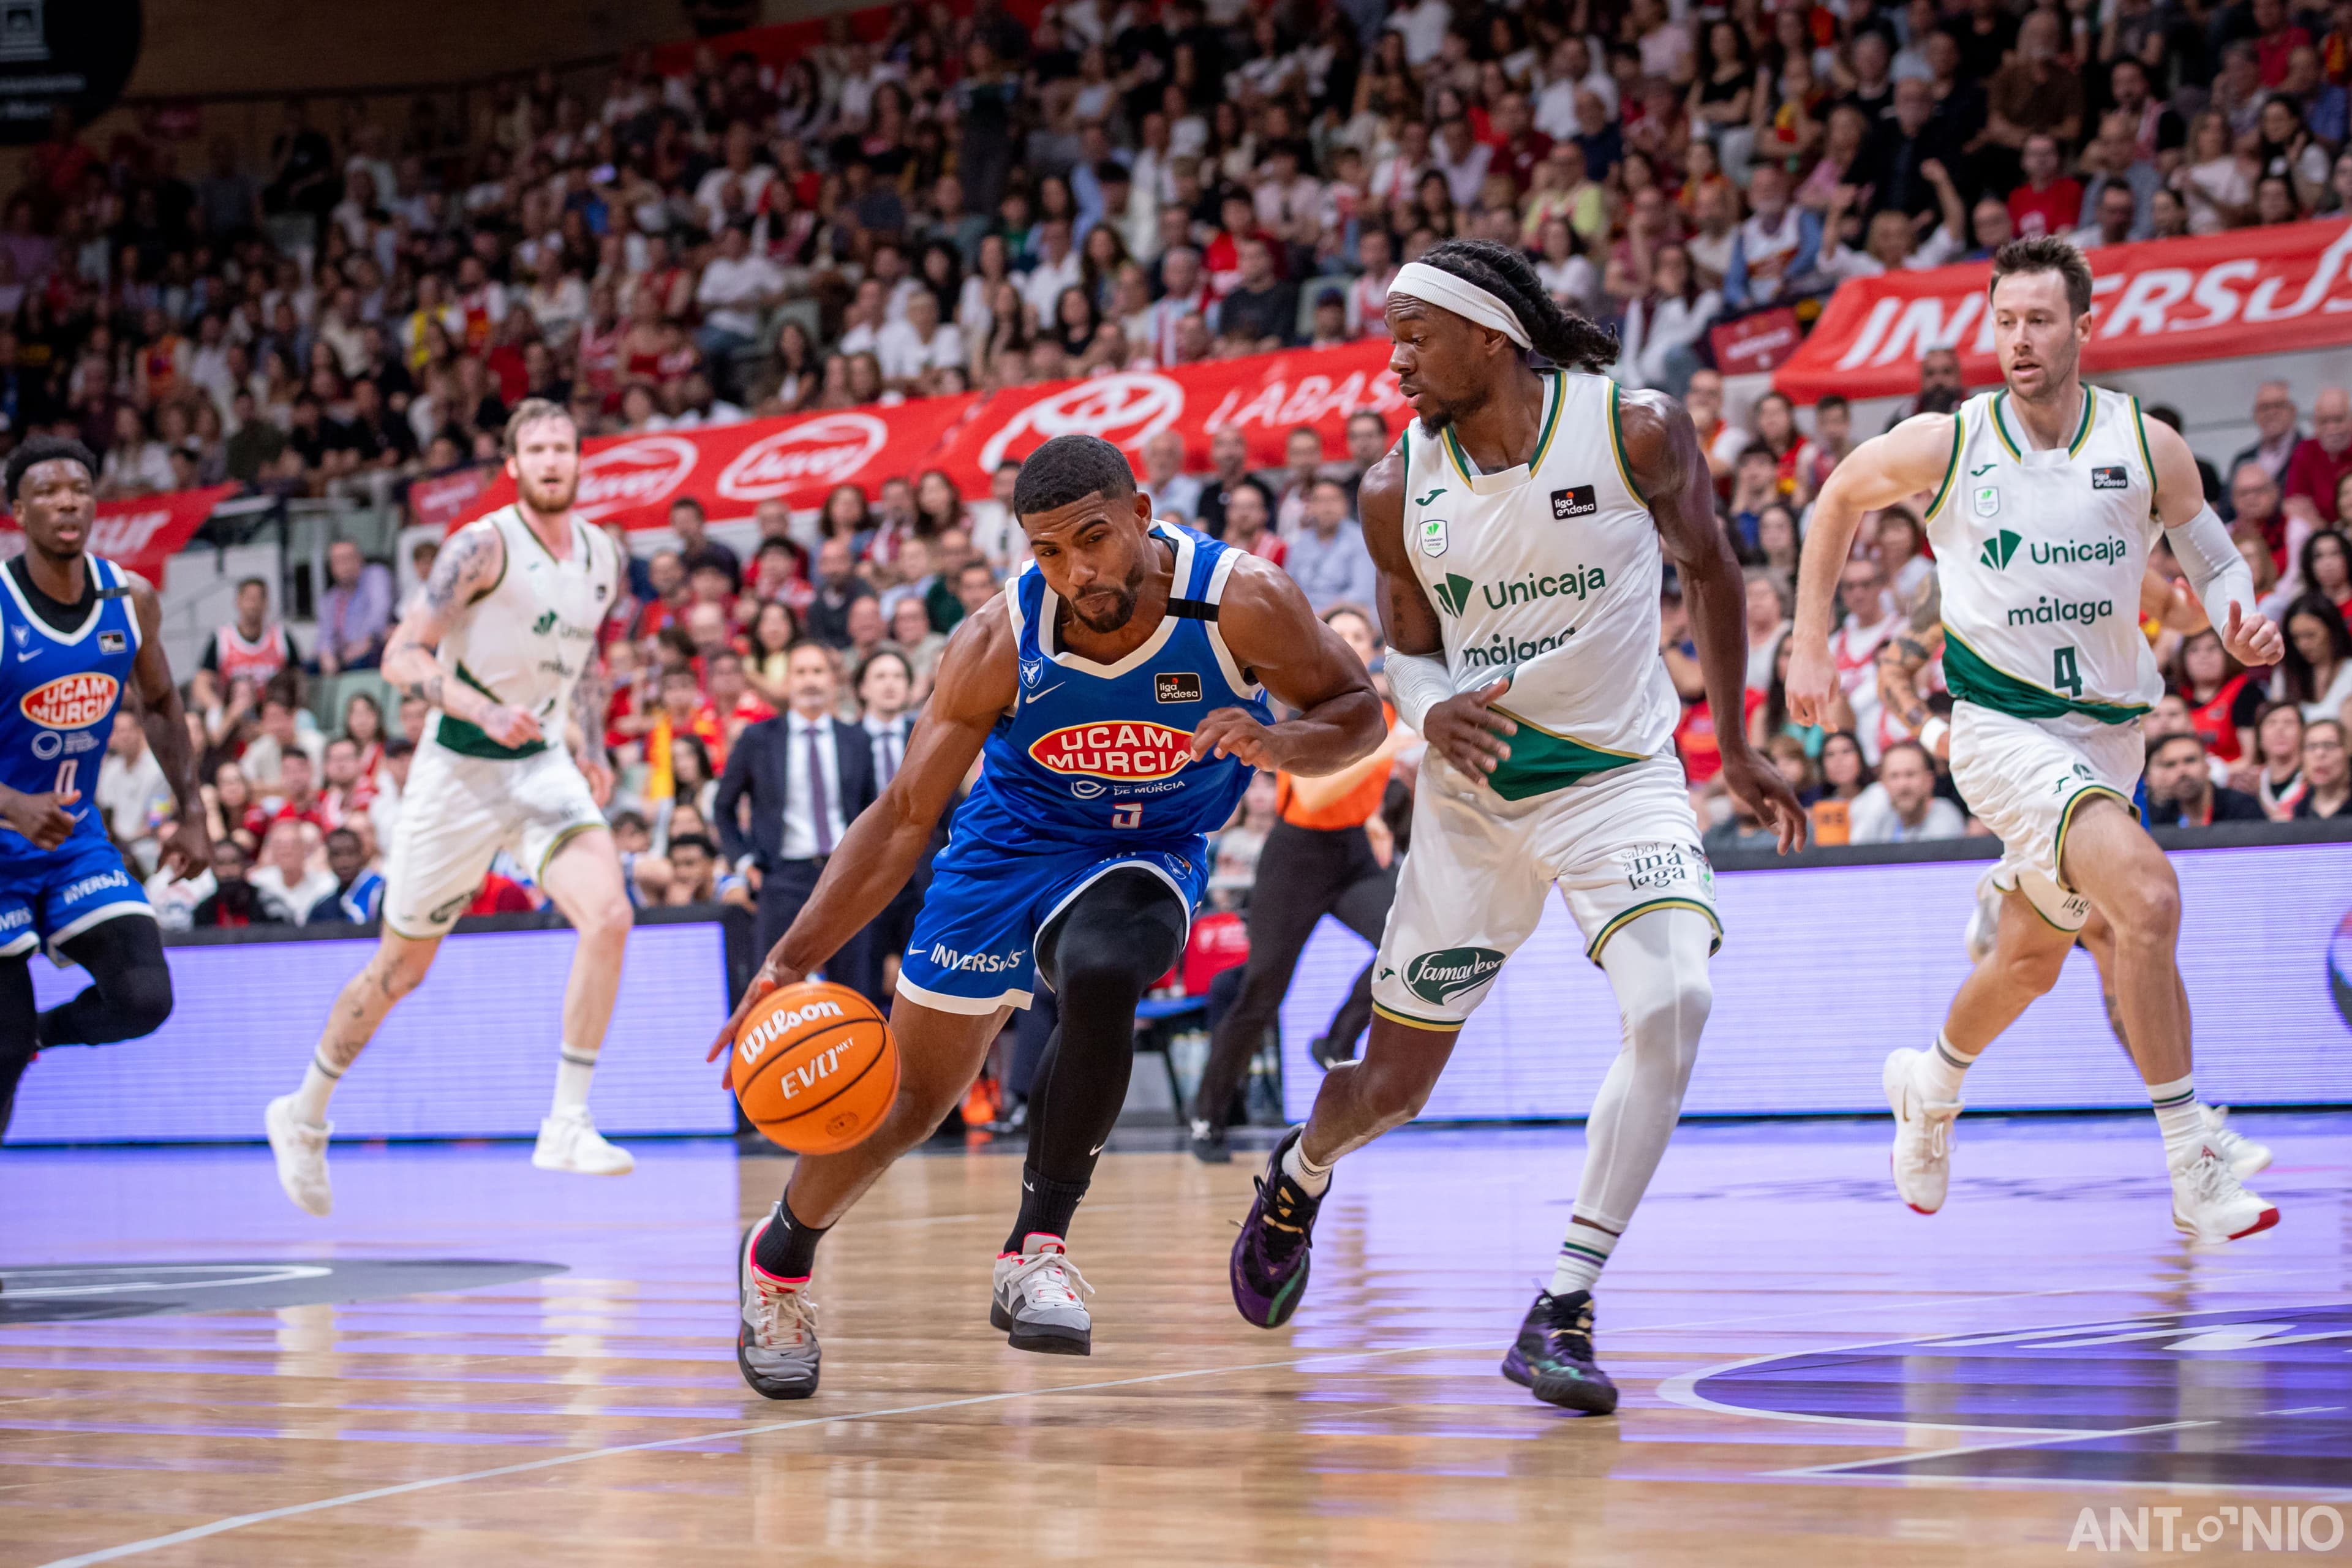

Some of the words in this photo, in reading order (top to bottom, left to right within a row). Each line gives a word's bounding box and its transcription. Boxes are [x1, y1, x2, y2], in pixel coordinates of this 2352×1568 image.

[1555, 499, 1574, 509] liga
[1556, 503, 1595, 516] endesa
[2030, 535, 2126, 565] Unicaja
[1483, 564, 1606, 610] Unicaja
[2054, 646, 2082, 697] 4
[43, 677, 108, 704] UCAM
[1159, 682, 1178, 692] liga
[1161, 690, 1198, 699] endesa
[1061, 725, 1173, 751] UCAM
[1047, 750, 1191, 773] MURCIA
[1621, 842, 1660, 859] sabor
[1629, 867, 1686, 891] laga
[739, 1000, 844, 1065] Wilson
[780, 1047, 839, 1100] EVO
[835, 1036, 854, 1054] NXT
